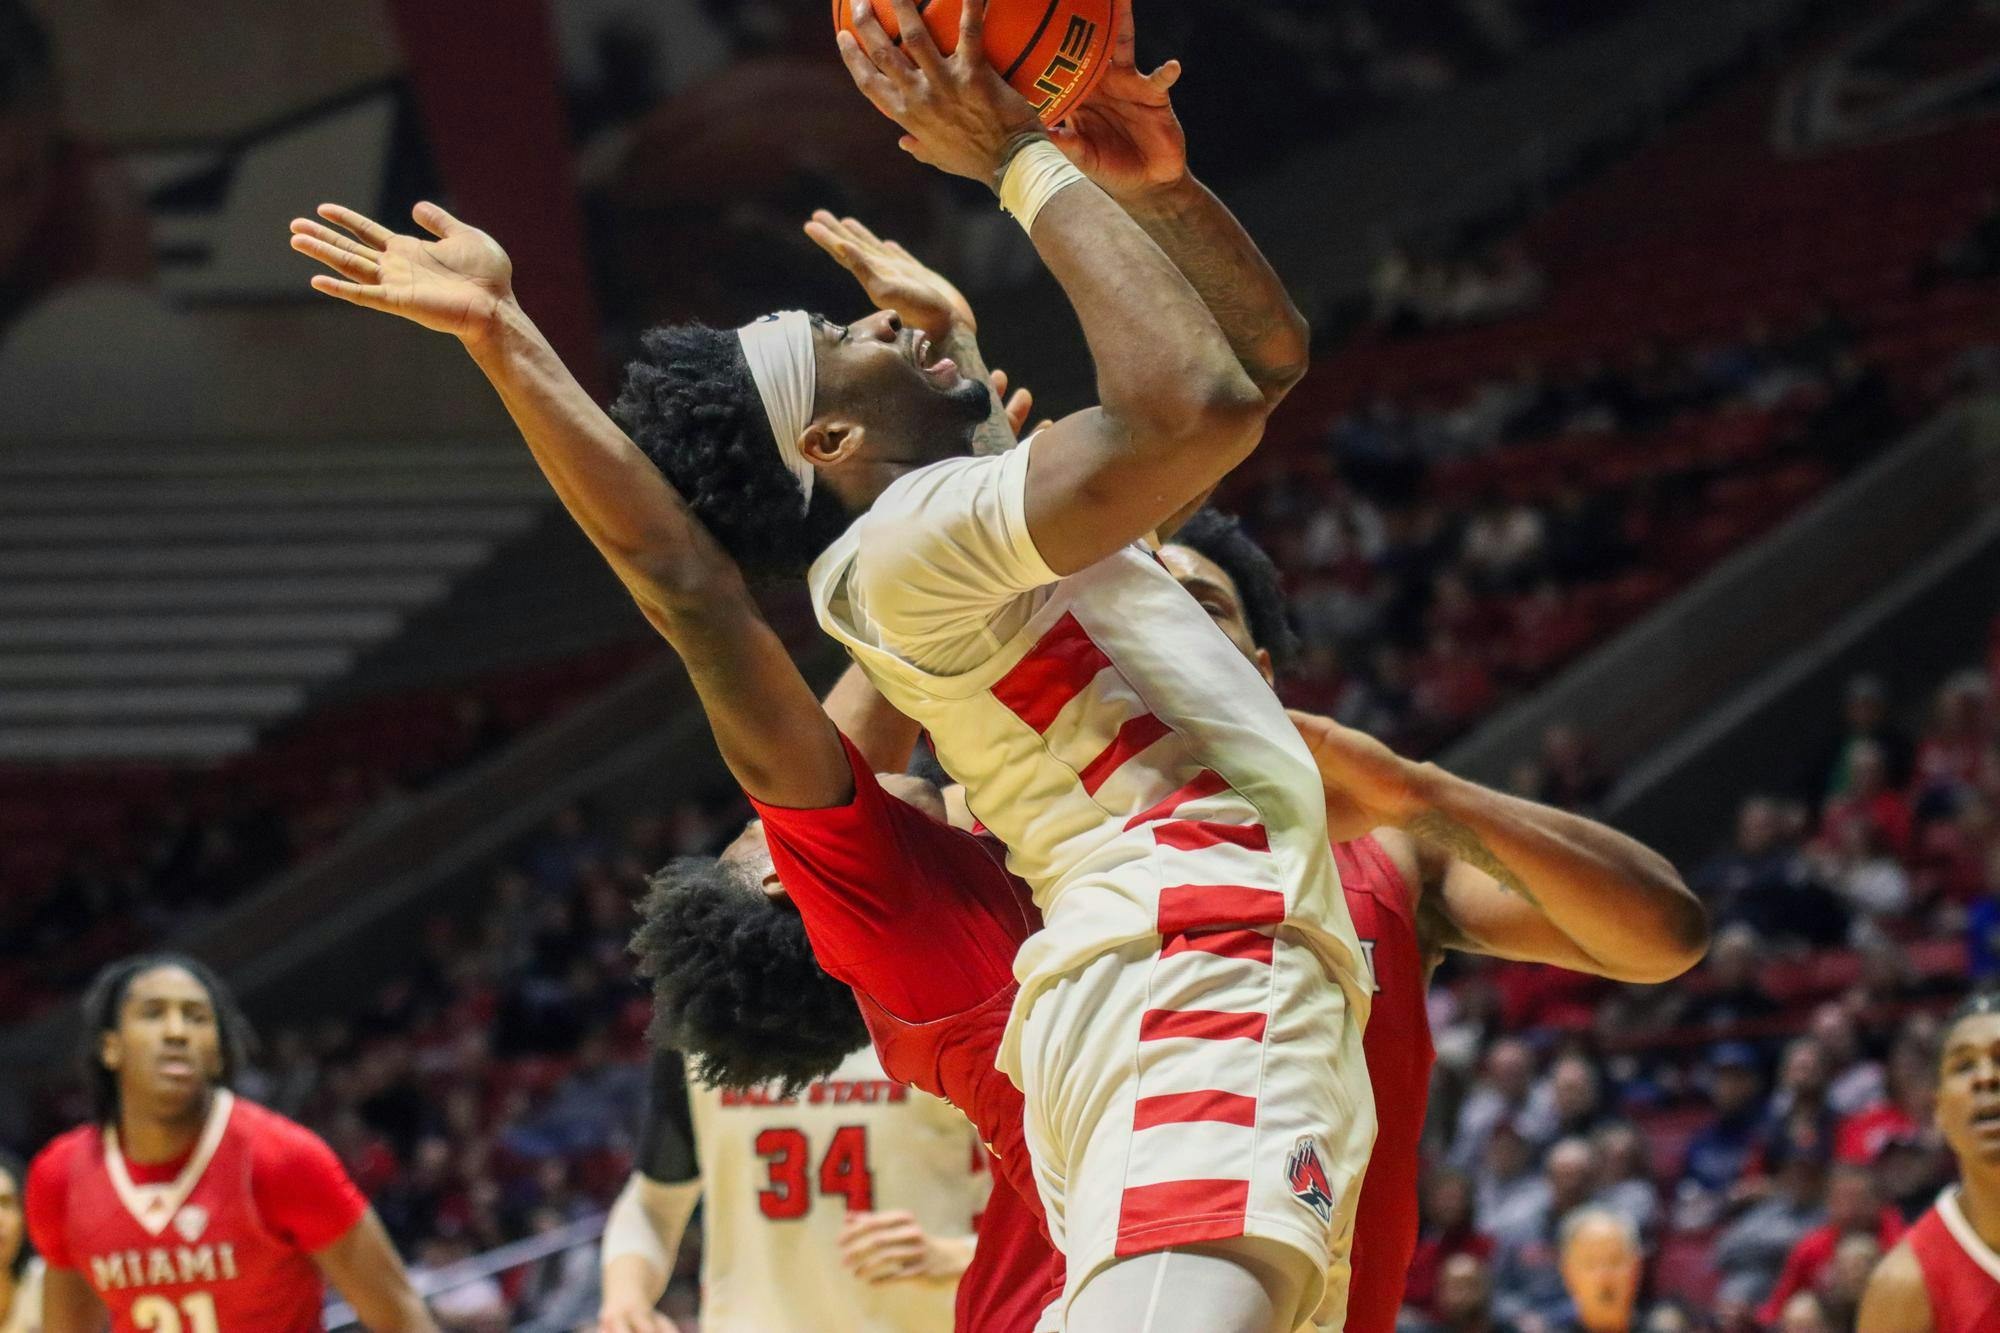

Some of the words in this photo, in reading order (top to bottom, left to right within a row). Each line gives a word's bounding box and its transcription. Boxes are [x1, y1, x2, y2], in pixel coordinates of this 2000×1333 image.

[1027, 12, 1097, 116] LITE
[755, 1126, 874, 1220] 34
[91, 1243, 238, 1291] MIAMI
